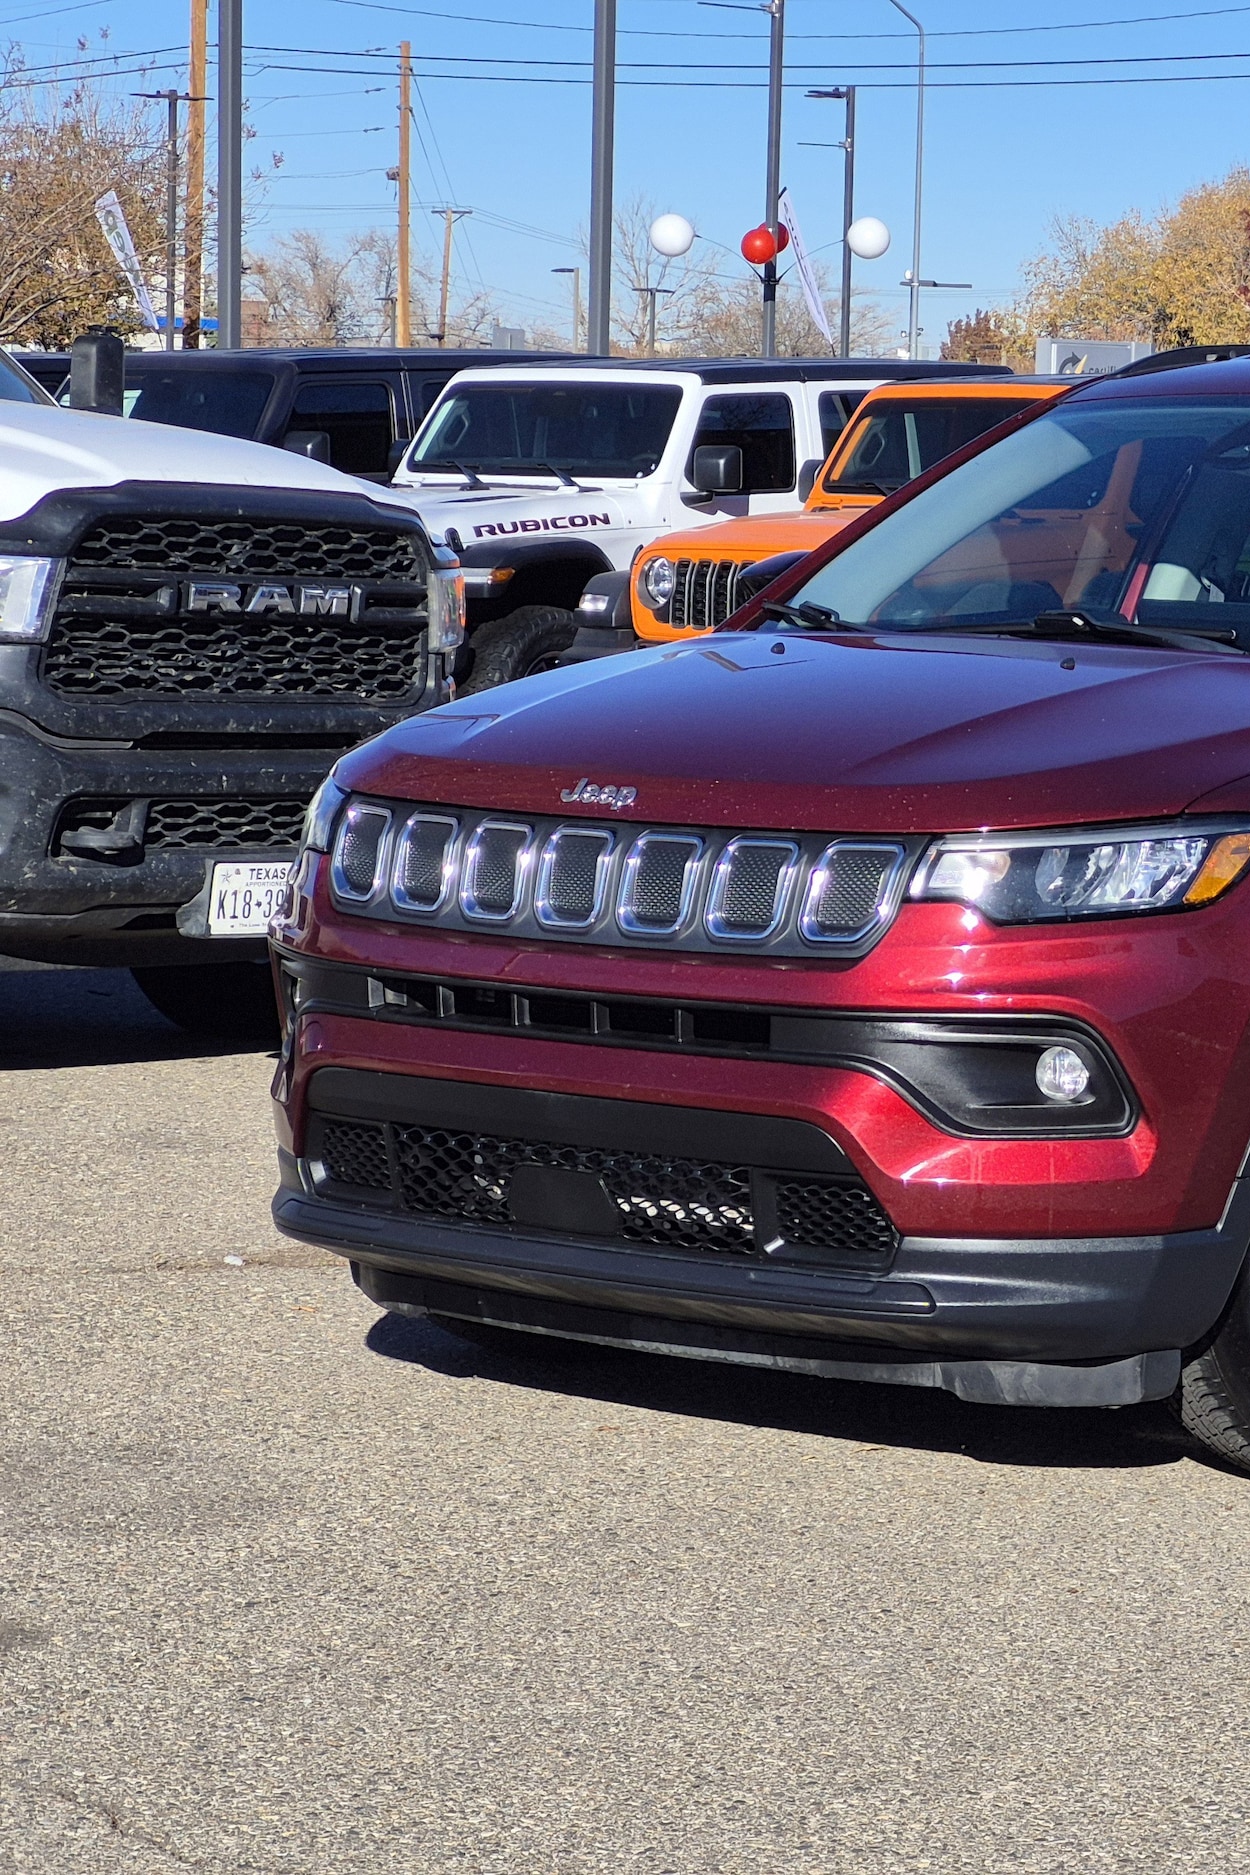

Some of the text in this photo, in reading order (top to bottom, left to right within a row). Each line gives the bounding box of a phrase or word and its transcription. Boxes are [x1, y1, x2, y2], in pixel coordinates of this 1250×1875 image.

[472, 513, 611, 538] RUBICON
[187, 582, 350, 615] RAM
[560, 777, 637, 811] Jeep
[249, 868, 286, 880] TEXAS
